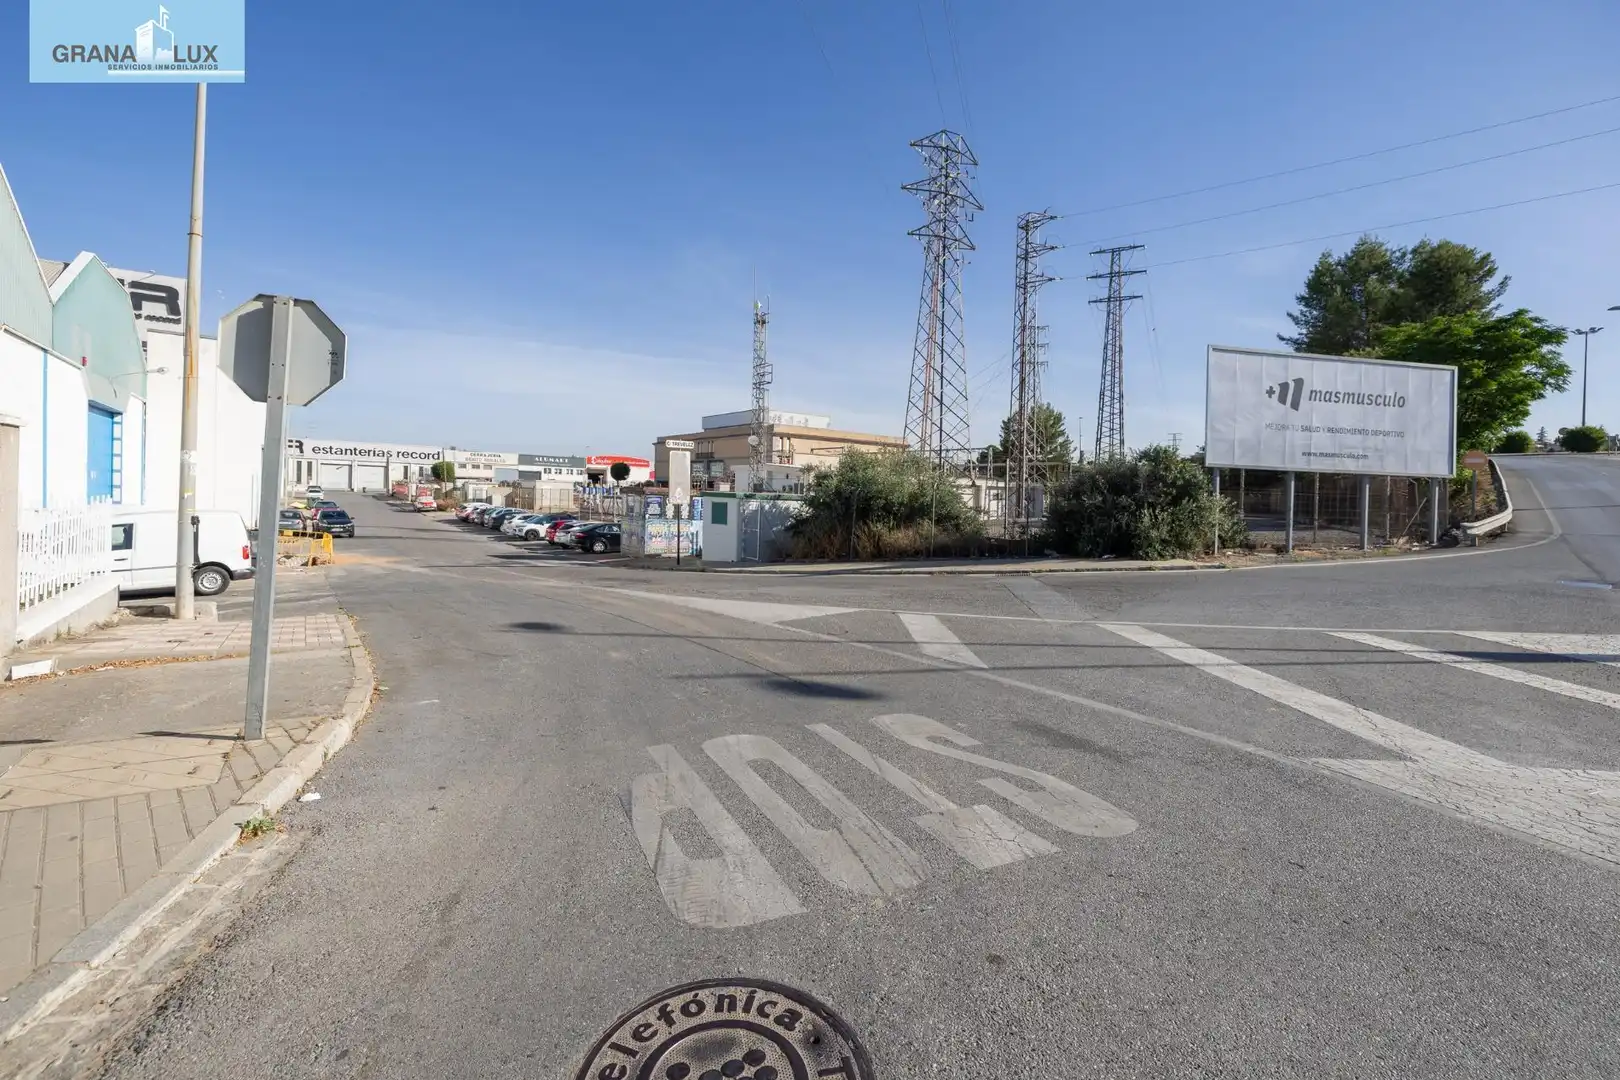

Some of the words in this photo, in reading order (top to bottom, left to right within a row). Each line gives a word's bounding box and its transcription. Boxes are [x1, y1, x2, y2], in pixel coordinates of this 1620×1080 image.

[1308, 387, 1406, 408] masmusculo
[1300, 424, 1321, 433] SALUD
[1327, 426, 1370, 436] RENDIMIENTO
[1371, 429, 1405, 438] DEPORTIVO
[396, 450, 440, 460] record
[598, 989, 804, 1080] elefónica
